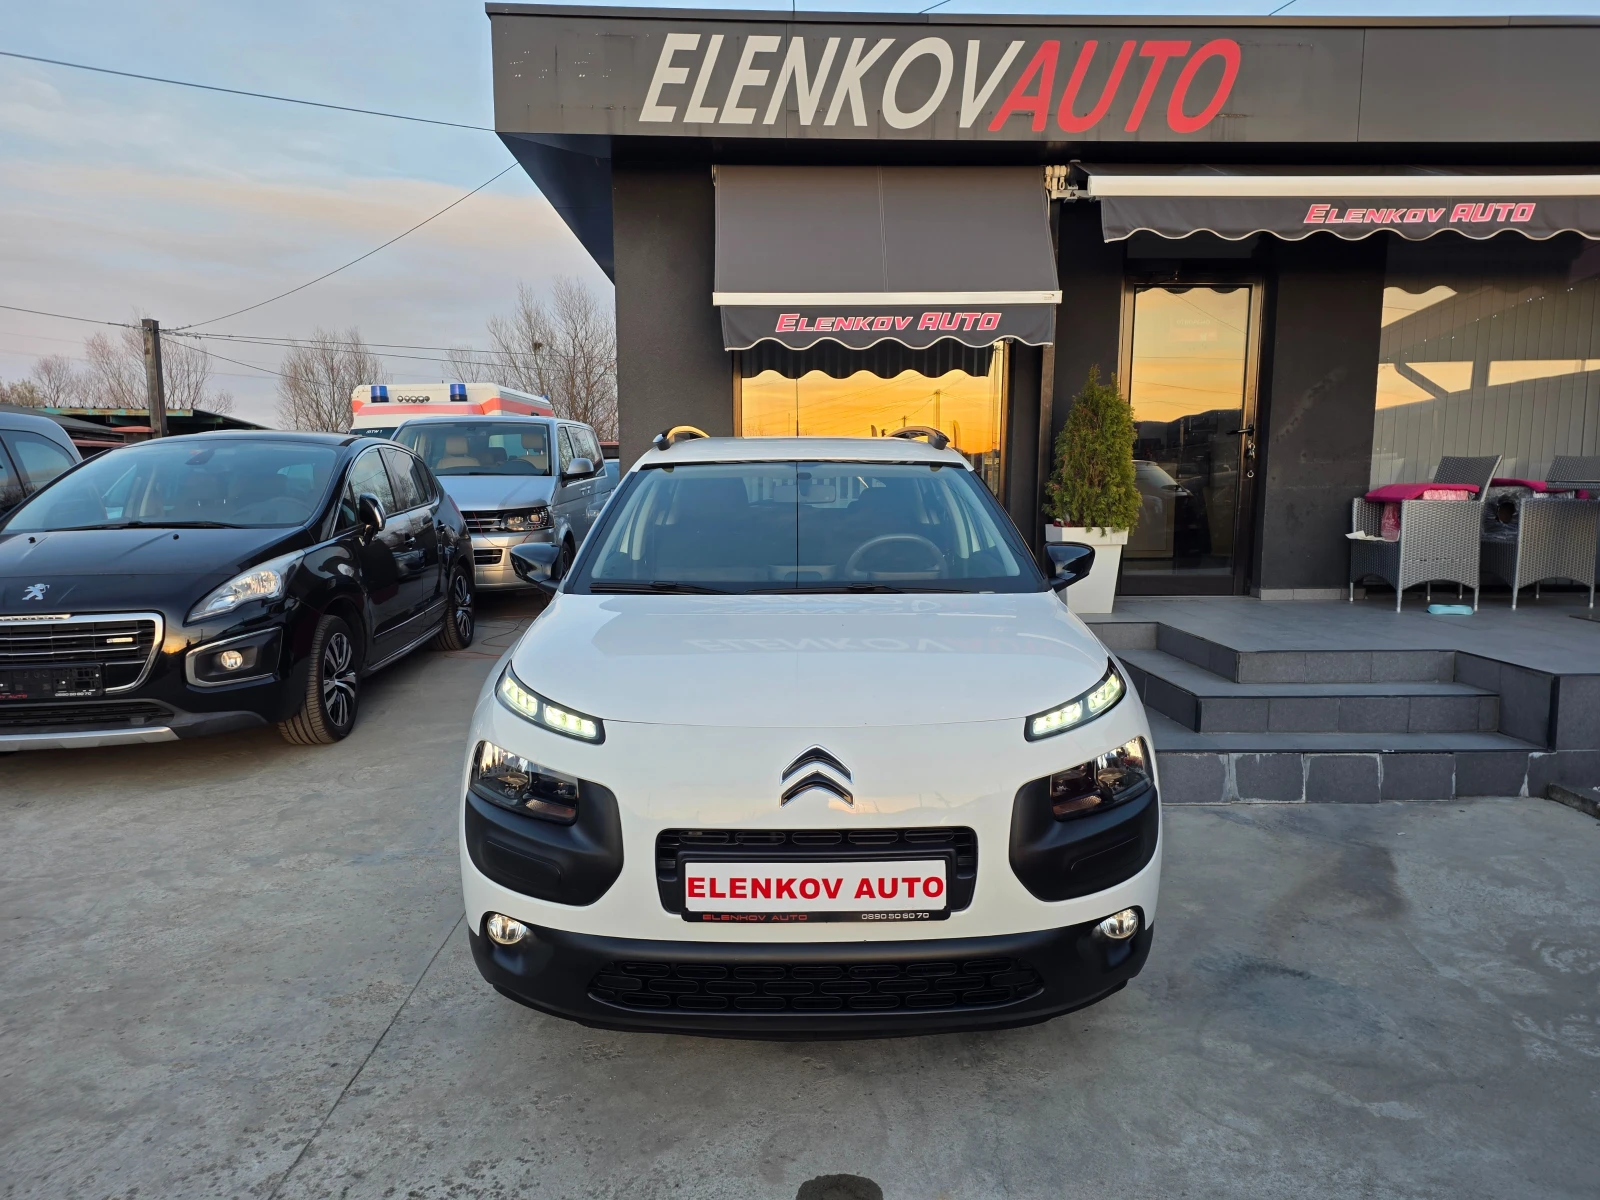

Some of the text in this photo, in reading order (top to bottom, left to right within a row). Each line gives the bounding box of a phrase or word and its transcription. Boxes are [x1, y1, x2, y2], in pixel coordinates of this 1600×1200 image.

[1304, 202, 1537, 224] ELENKOV AUTO
[775, 311, 1002, 333] ELENKOV AUTO
[687, 876, 945, 900] ELENKOV AUTO
